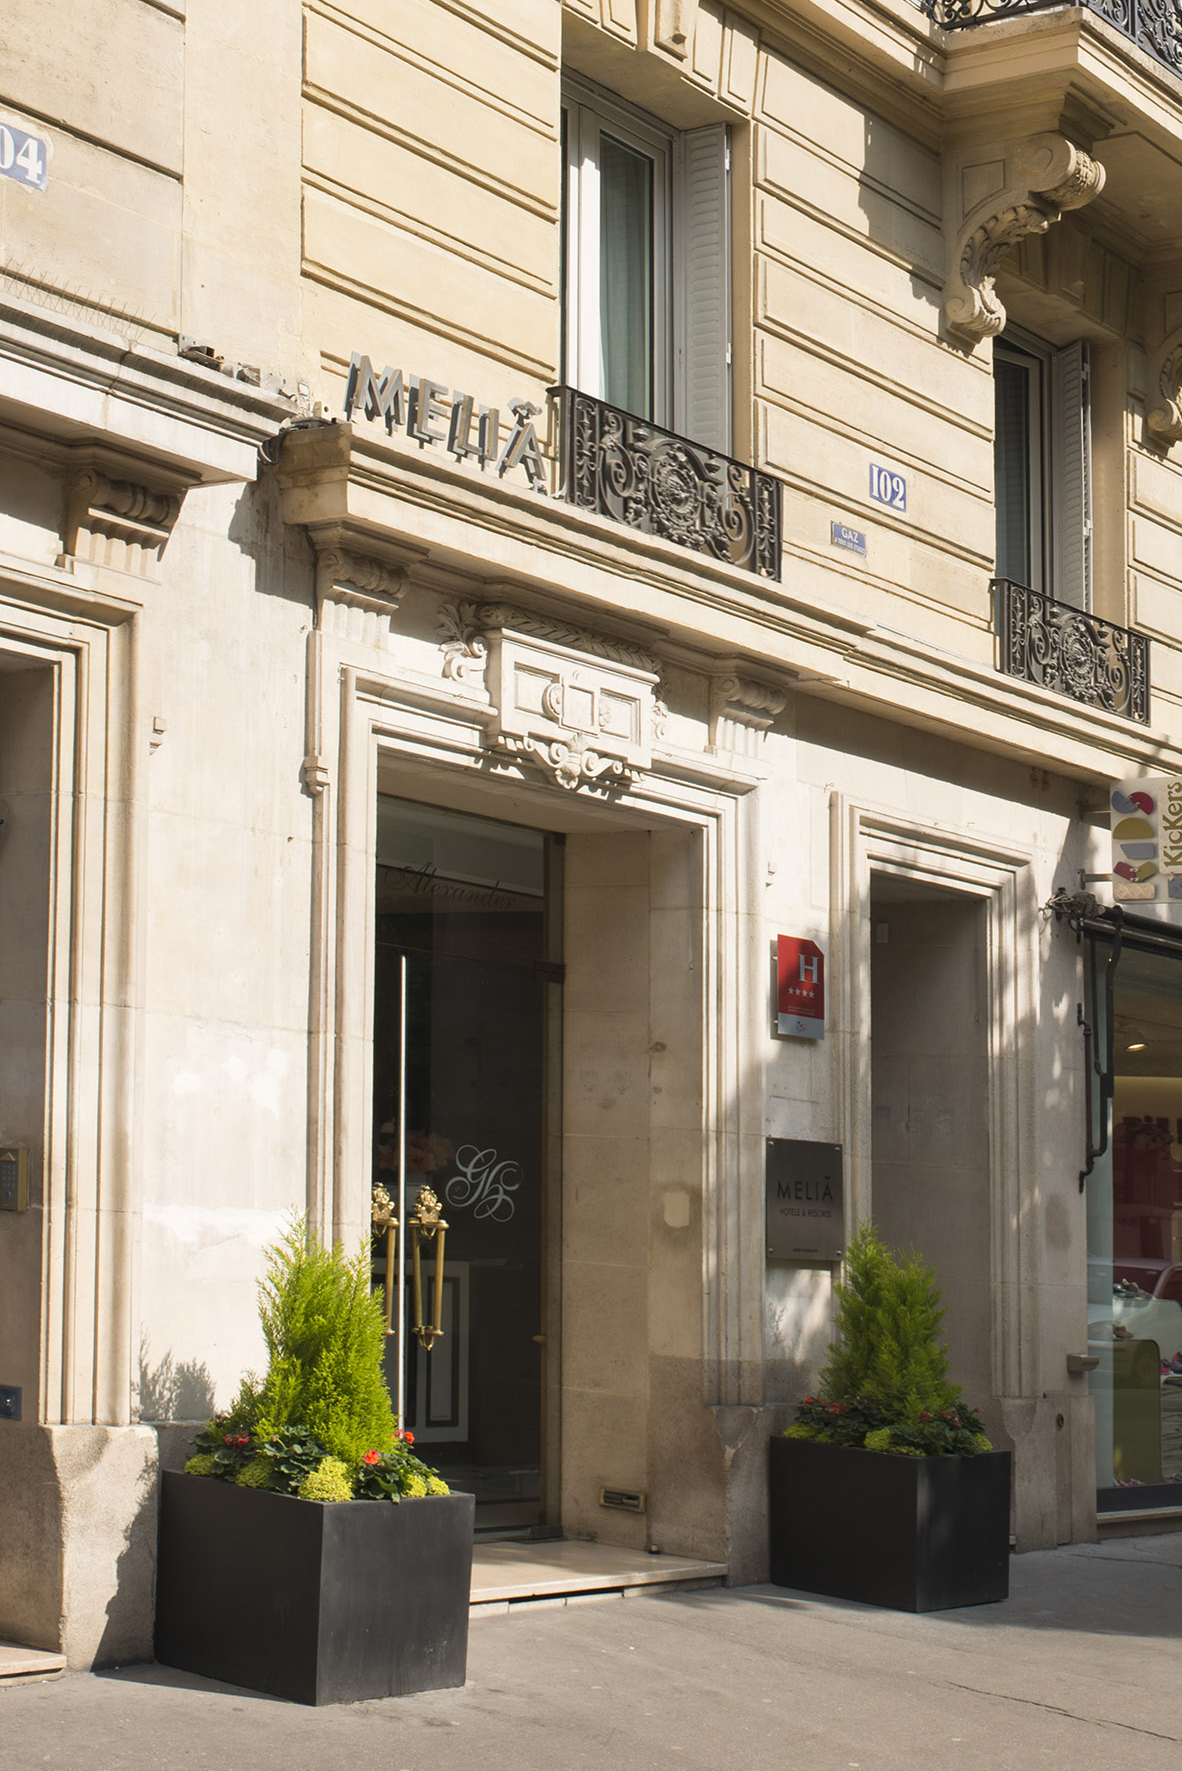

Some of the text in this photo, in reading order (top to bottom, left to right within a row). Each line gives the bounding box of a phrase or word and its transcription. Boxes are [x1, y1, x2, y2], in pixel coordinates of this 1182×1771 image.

[872, 465, 904, 509] 102
[841, 527, 859, 543] GAZ
[384, 862, 517, 910] Alexander
[797, 953, 820, 984] H
